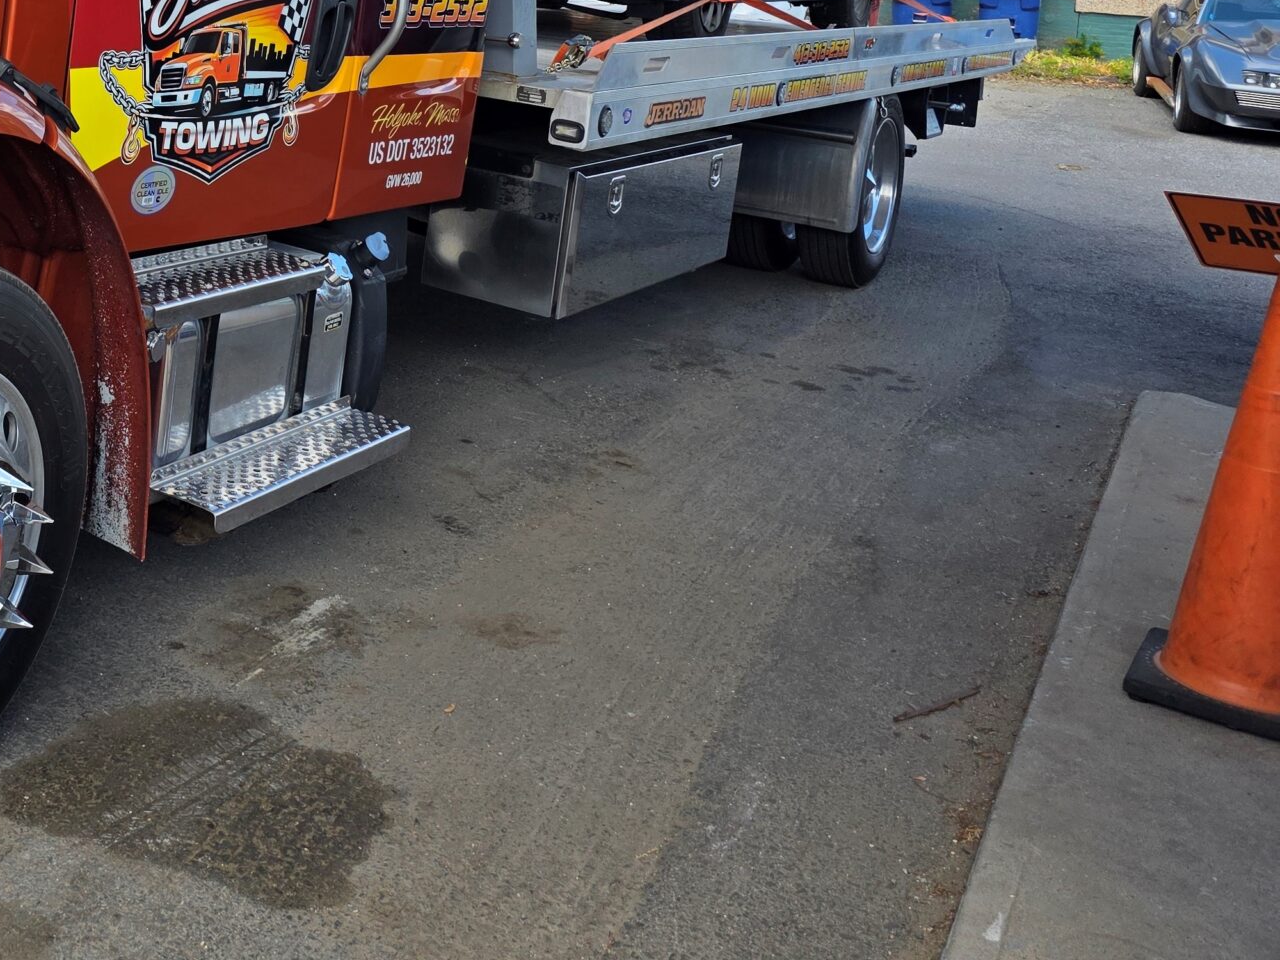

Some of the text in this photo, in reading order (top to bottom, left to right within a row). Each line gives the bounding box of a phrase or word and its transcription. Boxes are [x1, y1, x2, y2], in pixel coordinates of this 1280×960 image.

[730, 87, 748, 112] 24
[748, 82, 777, 109] HOUR
[784, 74, 836, 103] EMERGENCY
[835, 70, 869, 95] SERVICE
[159, 113, 270, 155] TOWING
[369, 134, 455, 164] US DOT 3523132
[140, 180, 168, 189] CERTIFIED
[386, 174, 402, 188] GVW
[1244, 204, 1280, 227] N
[1199, 222, 1280, 250] PAR
